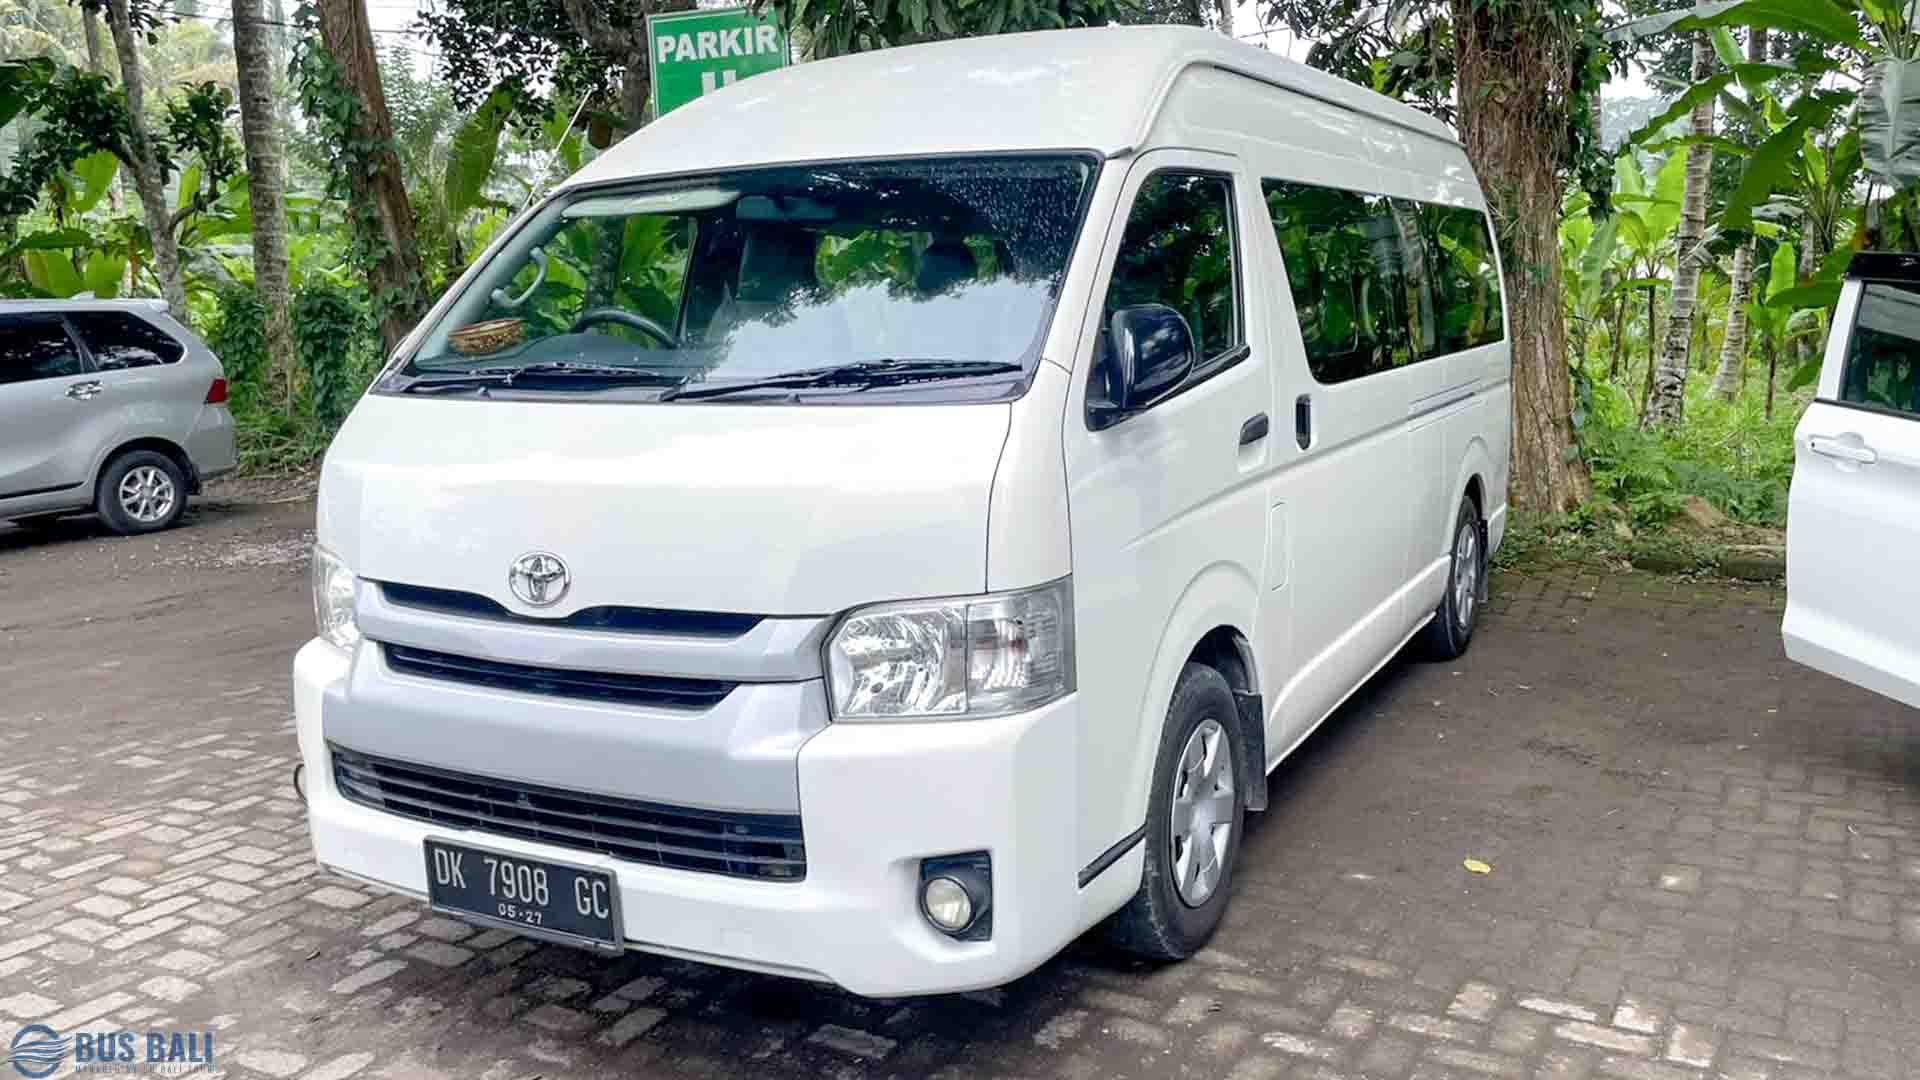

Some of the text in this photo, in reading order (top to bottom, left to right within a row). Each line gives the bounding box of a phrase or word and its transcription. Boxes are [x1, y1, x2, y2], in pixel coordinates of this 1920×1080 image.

[656, 24, 778, 64] PARKIR
[434, 848, 610, 920] DK 7908 GC
